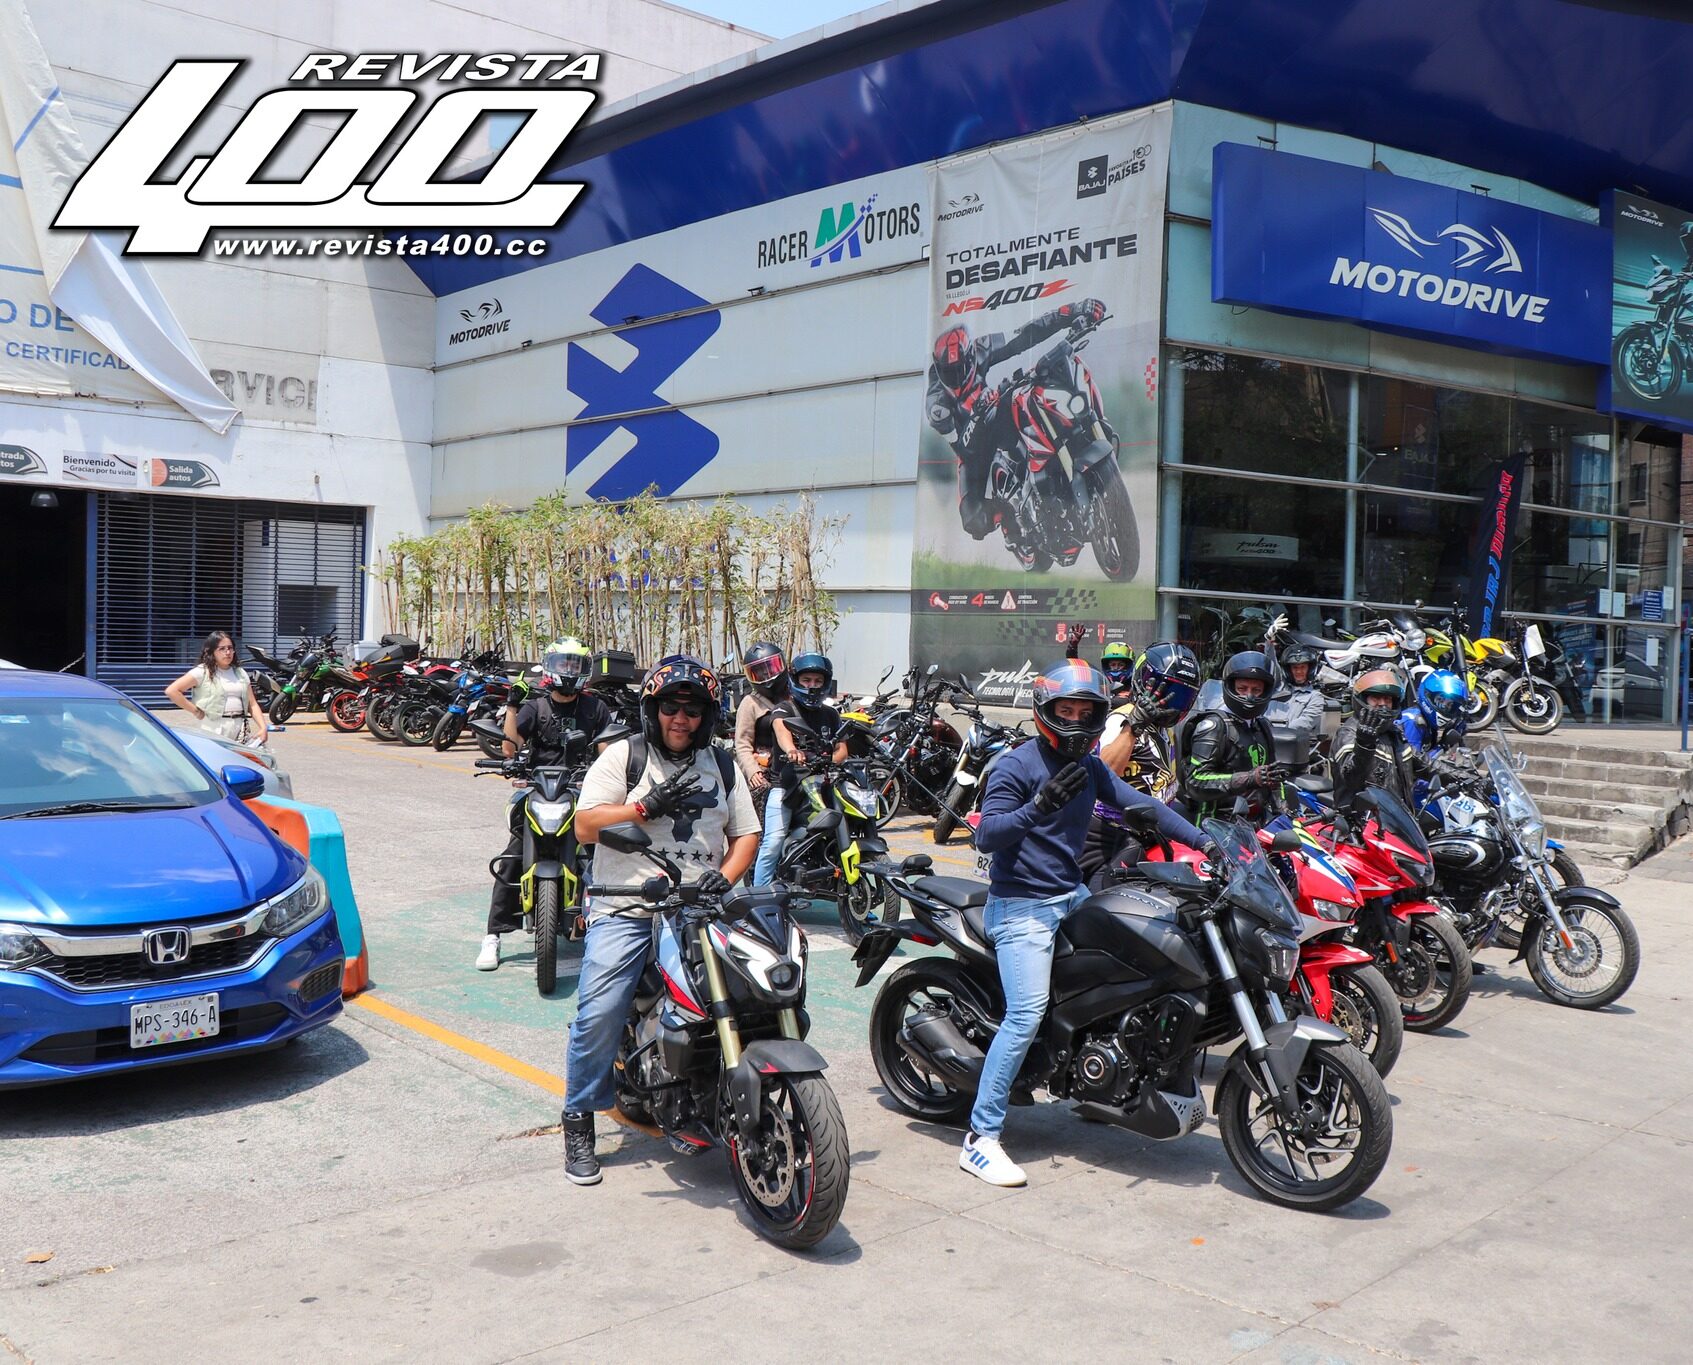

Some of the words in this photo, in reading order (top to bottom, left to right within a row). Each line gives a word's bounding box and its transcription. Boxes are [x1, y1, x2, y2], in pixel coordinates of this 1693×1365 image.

[1078, 179, 1106, 192] BAJAJ
[1108, 159, 1146, 187] PAÍSES
[937, 203, 985, 222] MOTODRIVE
[1620, 210, 1665, 228] MOTODRIVE
[757, 230, 808, 269] RACER
[946, 227, 1081, 265] TOTALMENTE
[946, 233, 1138, 290] DESAFIANTE
[1329, 256, 1551, 324] MOTODRIVE
[30, 303, 75, 332] DE
[449, 318, 511, 346] MOTODRIVE
[6, 341, 135, 371] CERTIFICAD
[63, 456, 116, 467] Bienvenido
[69, 465, 95, 475] Gracias
[96, 468, 108, 477] por
[169, 465, 193, 474] Salida
[970, 592, 984, 607] 4
[982, 686, 1014, 696] TECNOLOGÍA
[134, 1005, 216, 1035] MPS-346-A
